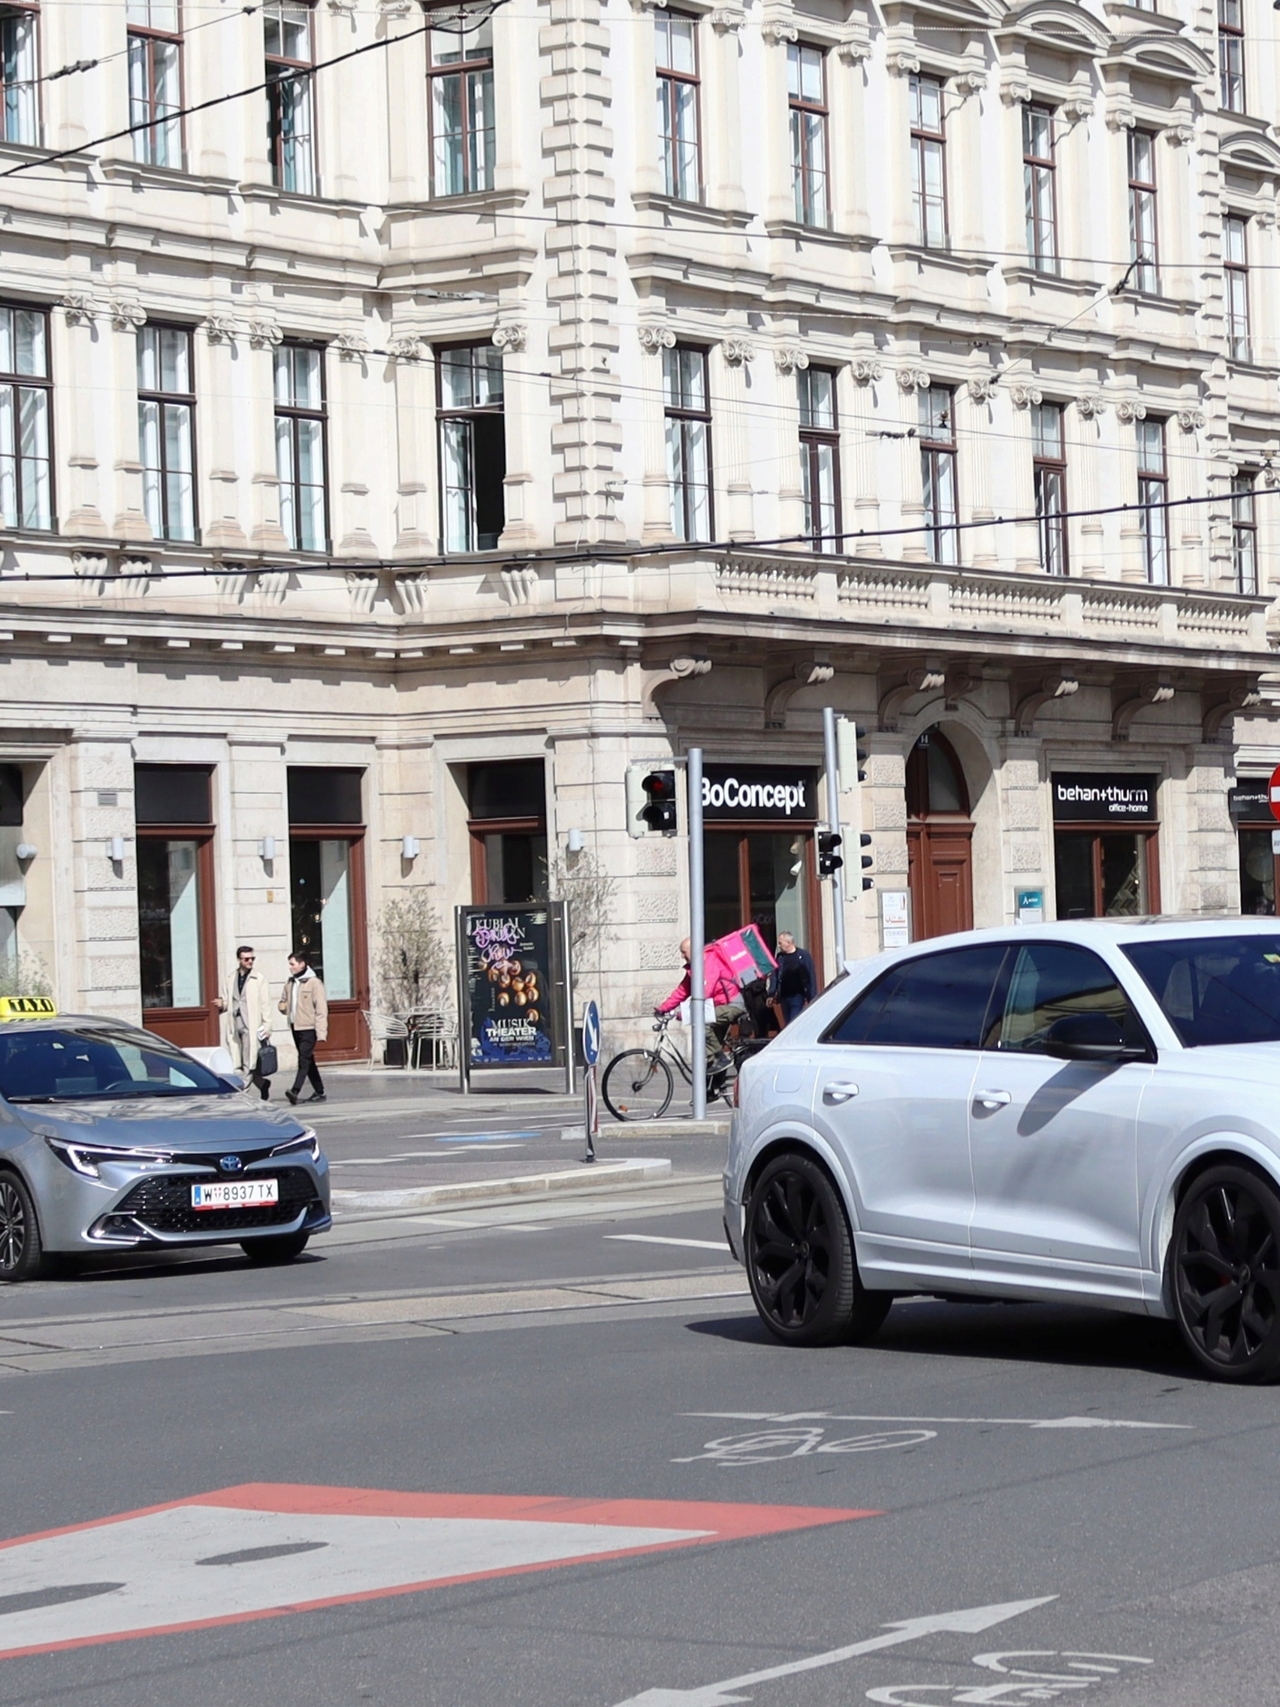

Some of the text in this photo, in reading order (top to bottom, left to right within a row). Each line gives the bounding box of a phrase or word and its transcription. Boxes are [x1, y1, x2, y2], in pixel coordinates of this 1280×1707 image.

[702, 777, 806, 815] BoConcept
[1057, 784, 1149, 802] behan+thurm
[10, 999, 52, 1011] TAXI
[491, 1018, 533, 1029] MUSIK
[485, 1027, 537, 1037] THEATER
[203, 1183, 273, 1202] W 8937 TX
